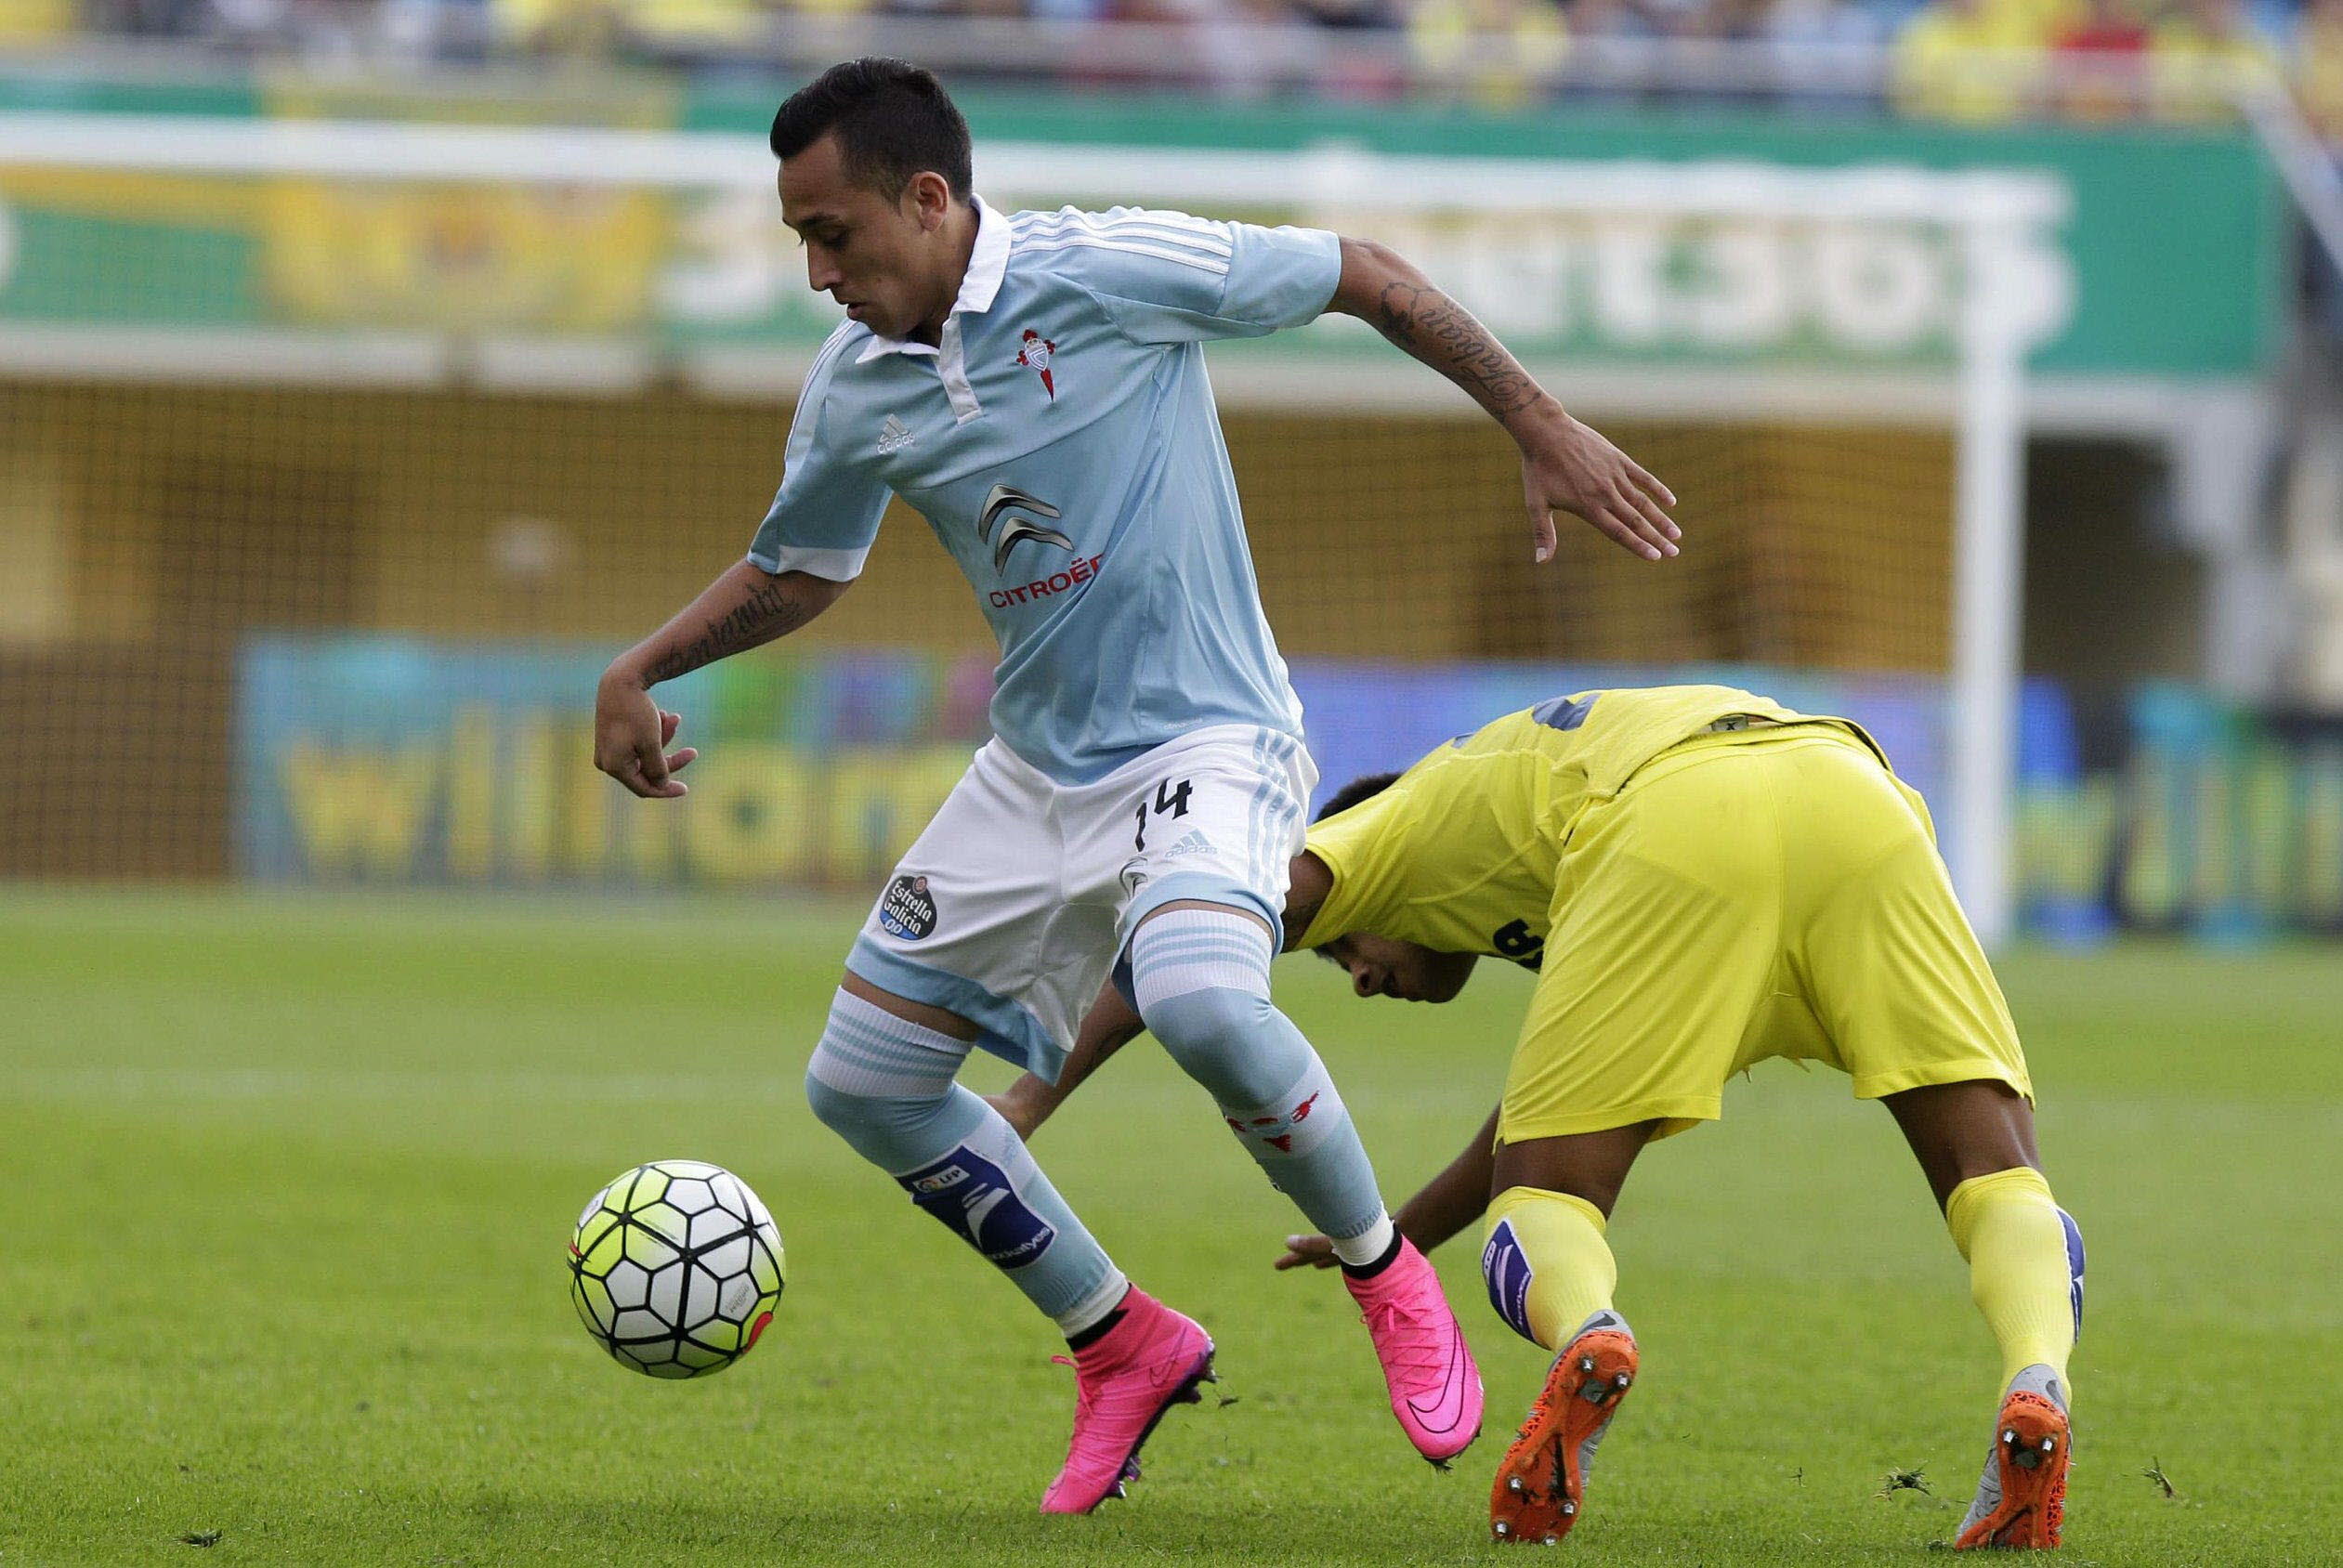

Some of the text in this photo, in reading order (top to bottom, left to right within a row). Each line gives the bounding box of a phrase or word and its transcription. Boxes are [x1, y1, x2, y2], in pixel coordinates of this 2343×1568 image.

[877, 432, 915, 454] adidas
[1134, 777, 1194, 853] 14
[1165, 845, 1218, 857] adidas
[884, 895, 922, 934] Galicia
[892, 880, 933, 922] Estrella
[939, 1169, 961, 1183] LFP
